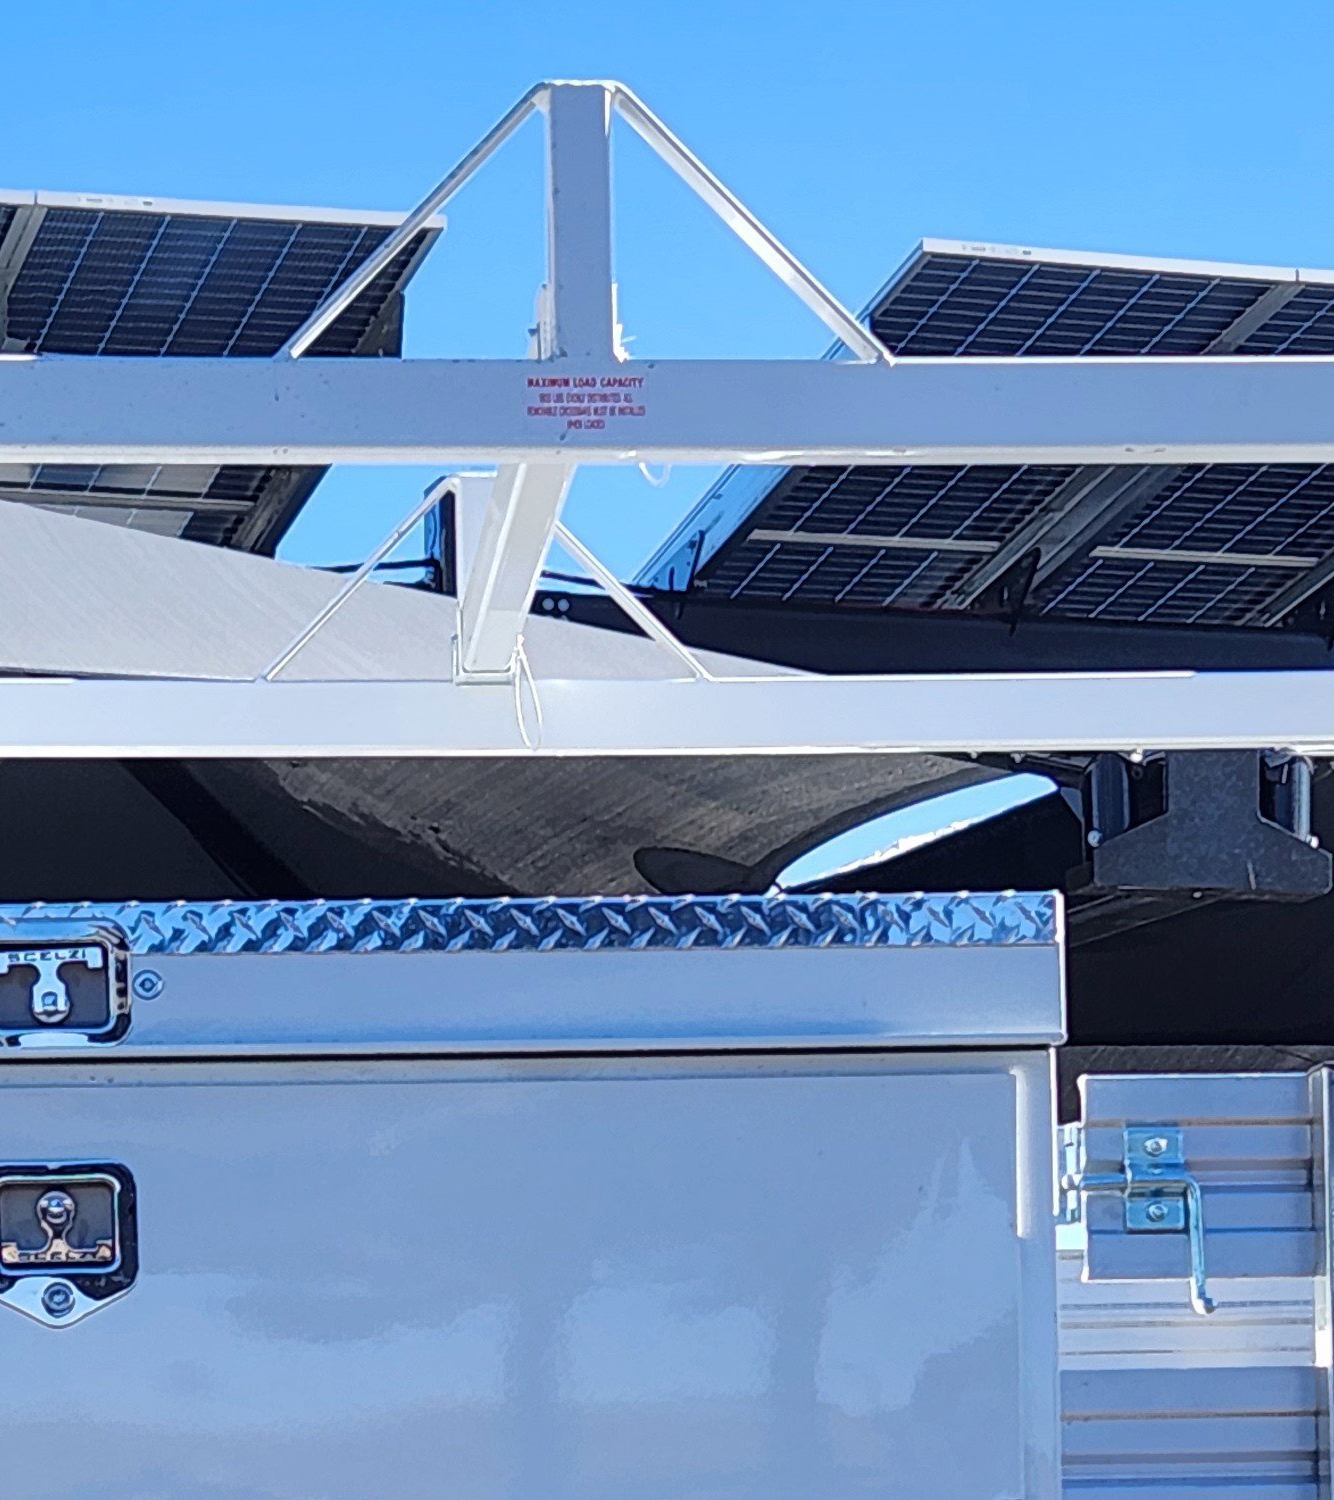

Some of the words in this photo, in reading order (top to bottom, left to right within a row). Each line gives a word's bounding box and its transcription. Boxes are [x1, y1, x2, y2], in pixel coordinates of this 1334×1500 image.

[527, 377, 570, 388] MAXIMUM
[573, 377, 597, 388] LOAD
[600, 377, 645, 388] CAPACITY
